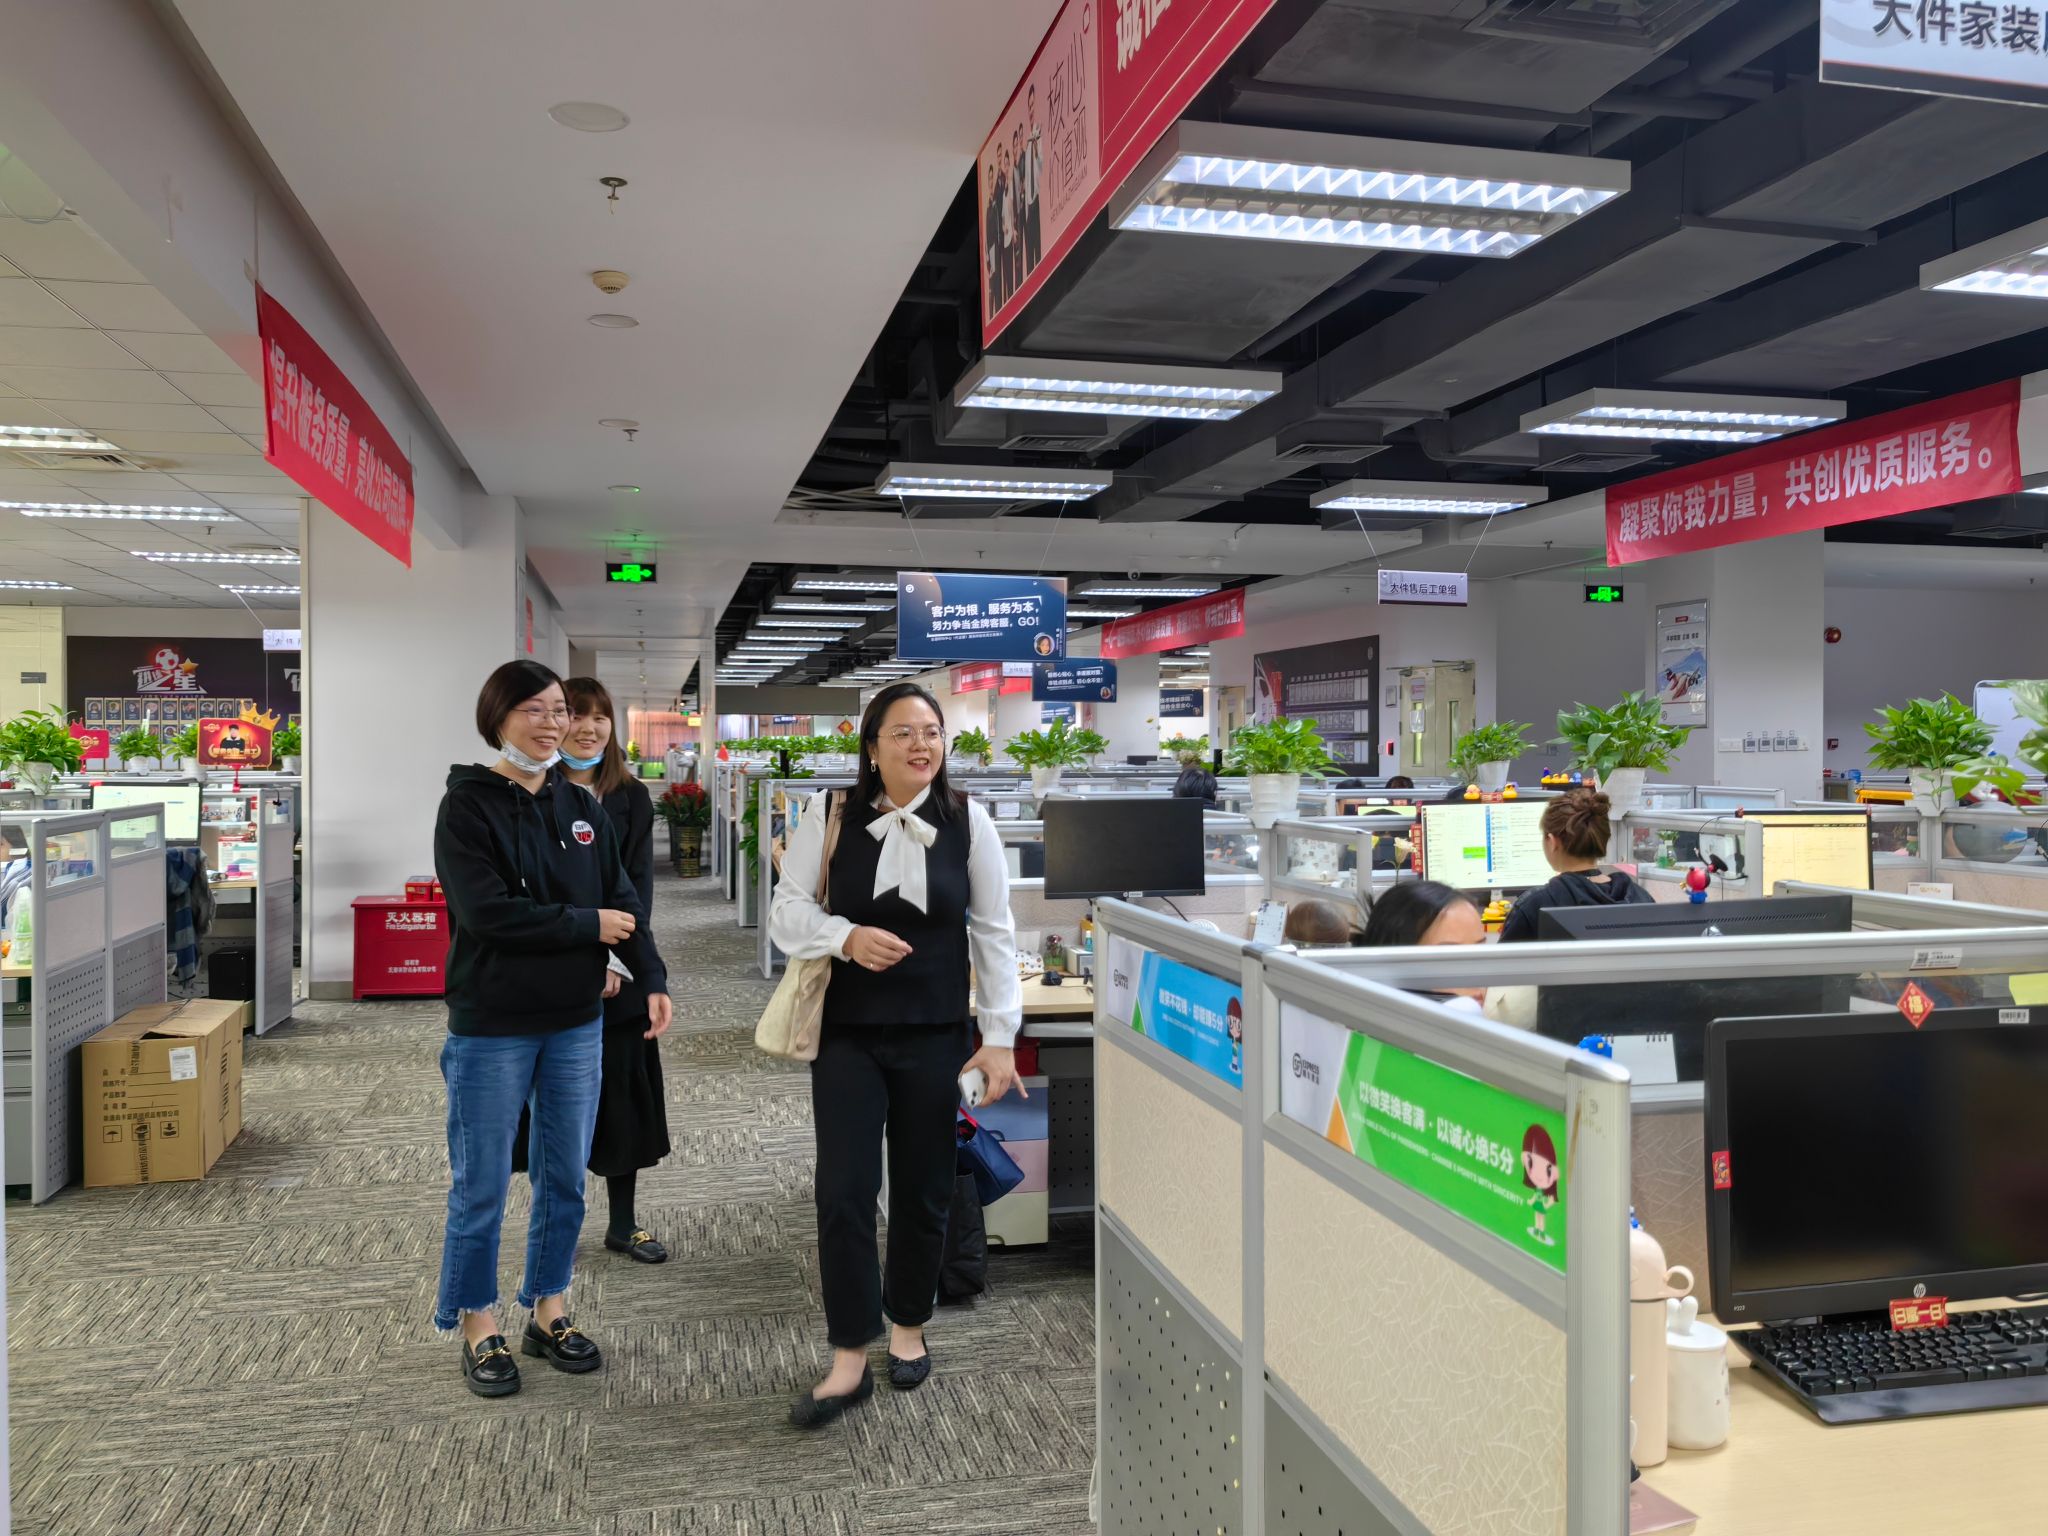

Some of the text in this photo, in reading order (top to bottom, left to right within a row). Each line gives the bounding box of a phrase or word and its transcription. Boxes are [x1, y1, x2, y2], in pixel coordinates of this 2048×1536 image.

[1873, 0, 2048, 54] 大件家装
[1047, 32, 1086, 144] 核心
[1049, 105, 1088, 207] 价值观
[1619, 421, 1993, 542] 凝聚你我力量，共创优质服务。
[1390, 582, 1457, 595] 大件售后工单组
[385, 911, 437, 923] 灭火器箱
